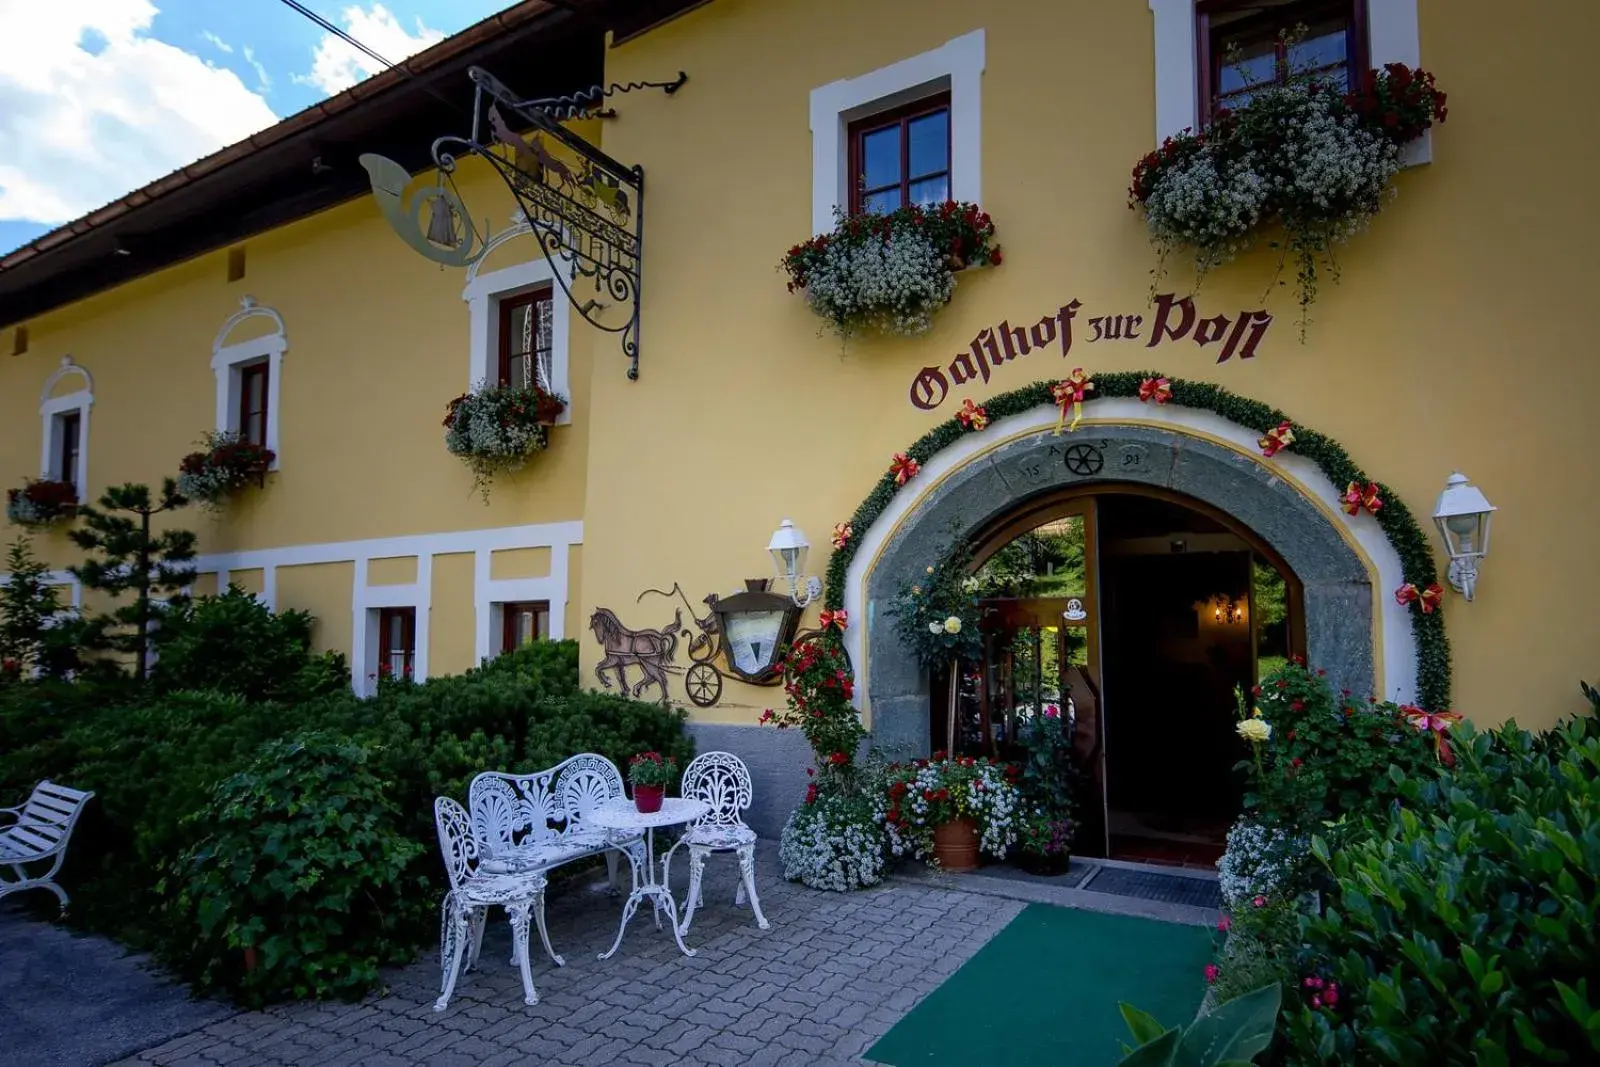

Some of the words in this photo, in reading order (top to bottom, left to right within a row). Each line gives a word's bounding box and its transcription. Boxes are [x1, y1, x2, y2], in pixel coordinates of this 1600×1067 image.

[910, 297, 1083, 410] Gasthof
[1085, 313, 1143, 343] zur
[1145, 292, 1275, 365] Post
[1048, 445, 1061, 457] A
